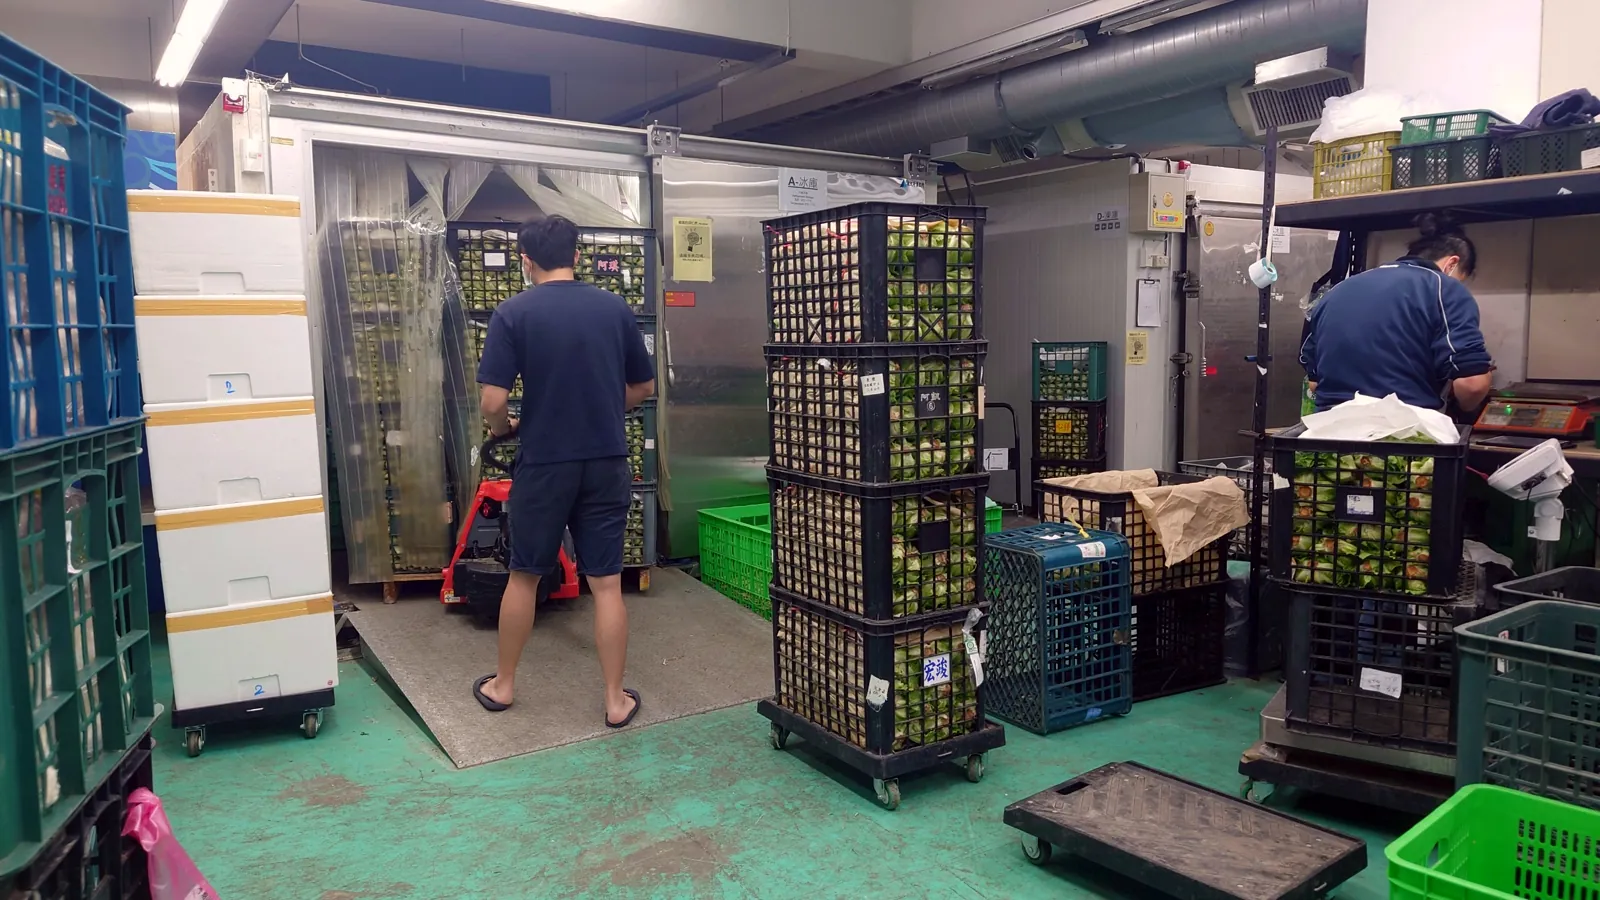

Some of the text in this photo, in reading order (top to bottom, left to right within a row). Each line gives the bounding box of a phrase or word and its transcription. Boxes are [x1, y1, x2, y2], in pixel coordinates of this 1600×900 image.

[225, 380, 235, 394] 2
[924, 656, 949, 682] 宏竣
[253, 684, 265, 696] 2
